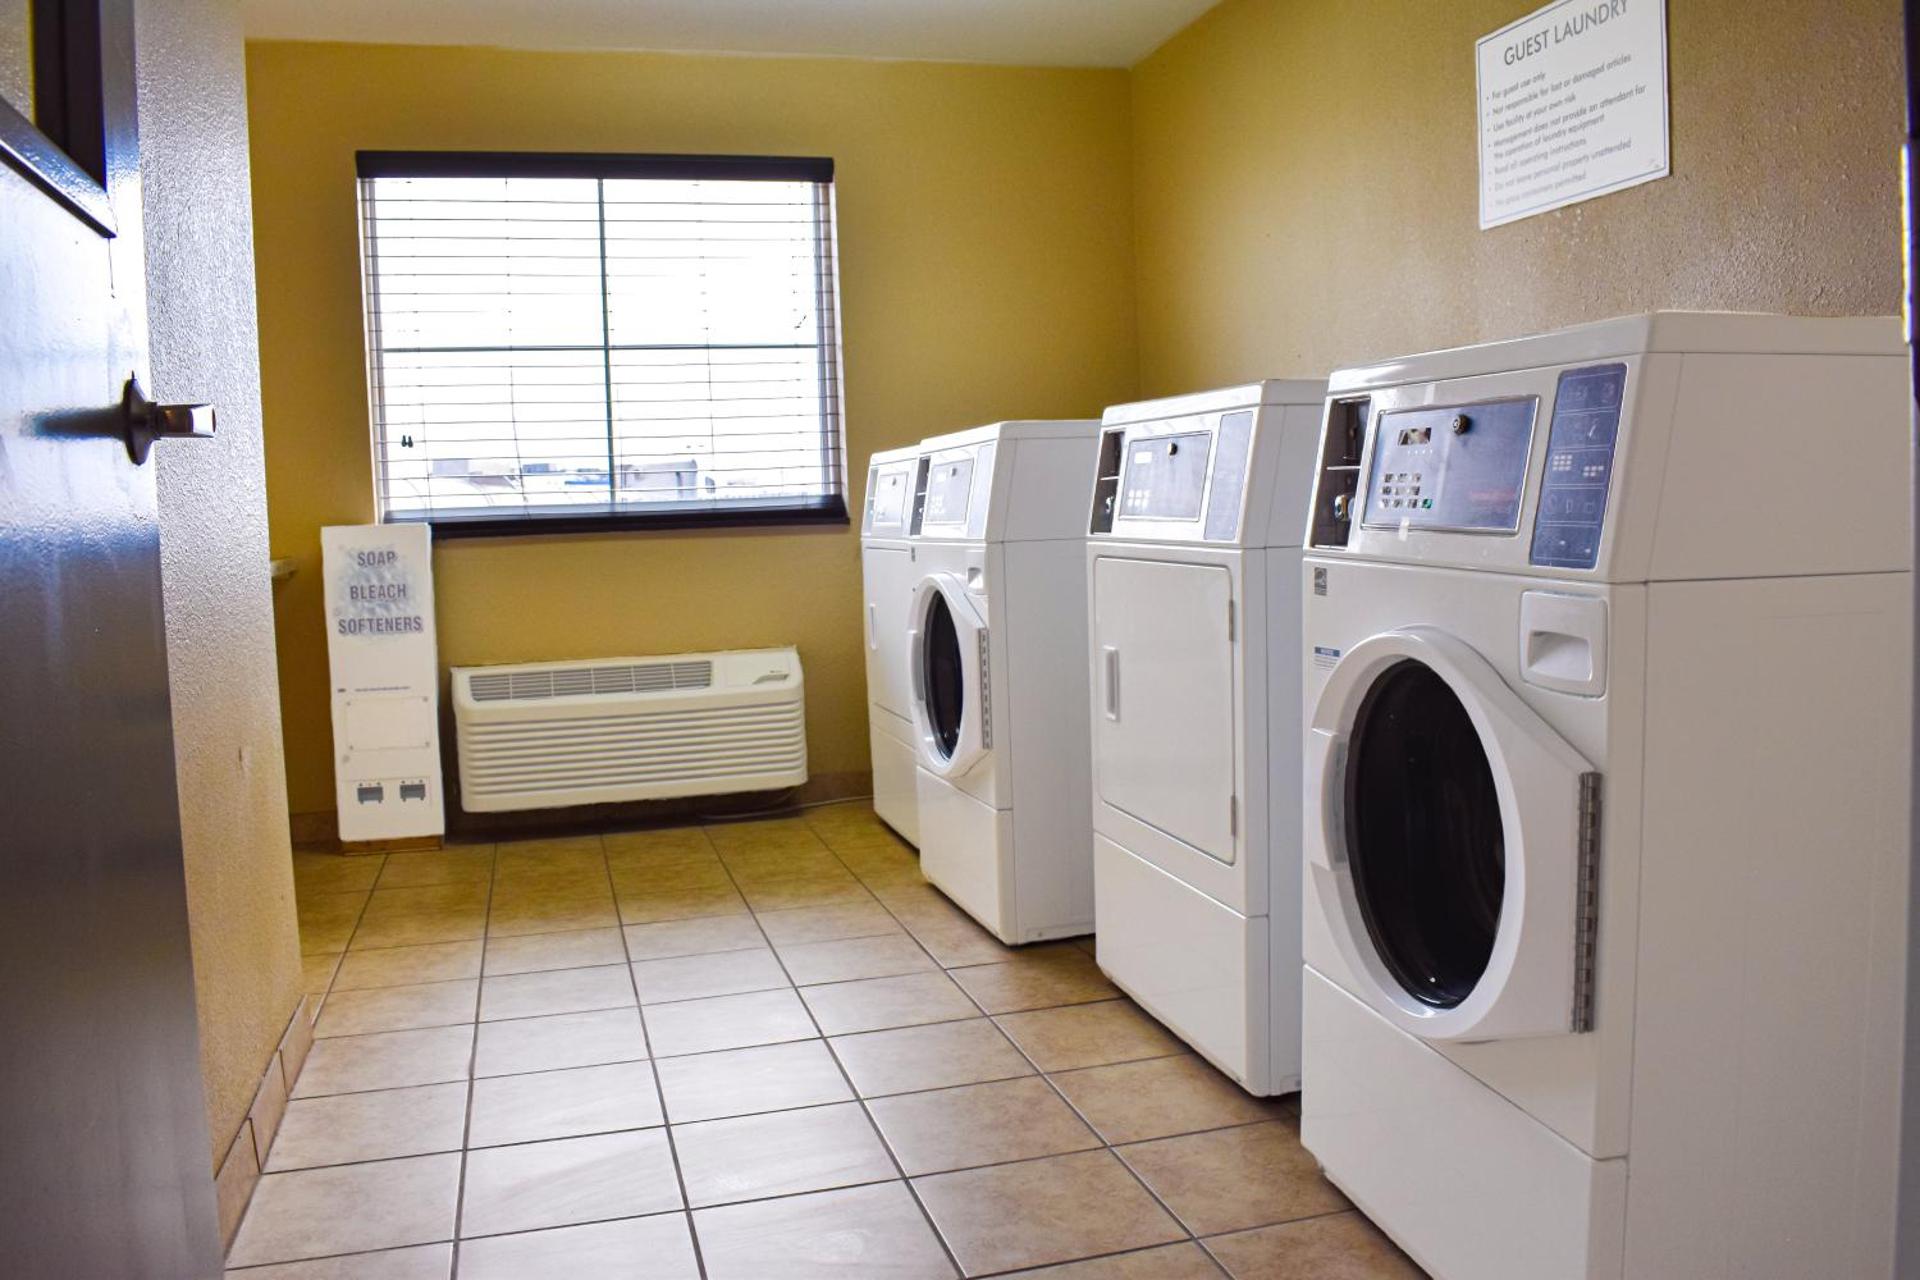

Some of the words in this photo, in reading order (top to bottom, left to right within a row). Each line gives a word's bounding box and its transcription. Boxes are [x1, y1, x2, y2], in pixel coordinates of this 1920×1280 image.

[1504, 29, 1550, 66] GUEST
[1554, 0, 1628, 44] LAUNDRY
[1532, 72, 1546, 84] only
[1573, 63, 1605, 84] damaged
[1606, 53, 1632, 70] articles
[1562, 106, 1587, 124] provide
[1600, 88, 1634, 109] attendant
[1635, 84, 1647, 96] for
[1568, 113, 1605, 135] equipment
[357, 551, 396, 567] SOAP
[350, 584, 407, 600] BLEACH
[338, 616, 422, 634] SOFTENERS
